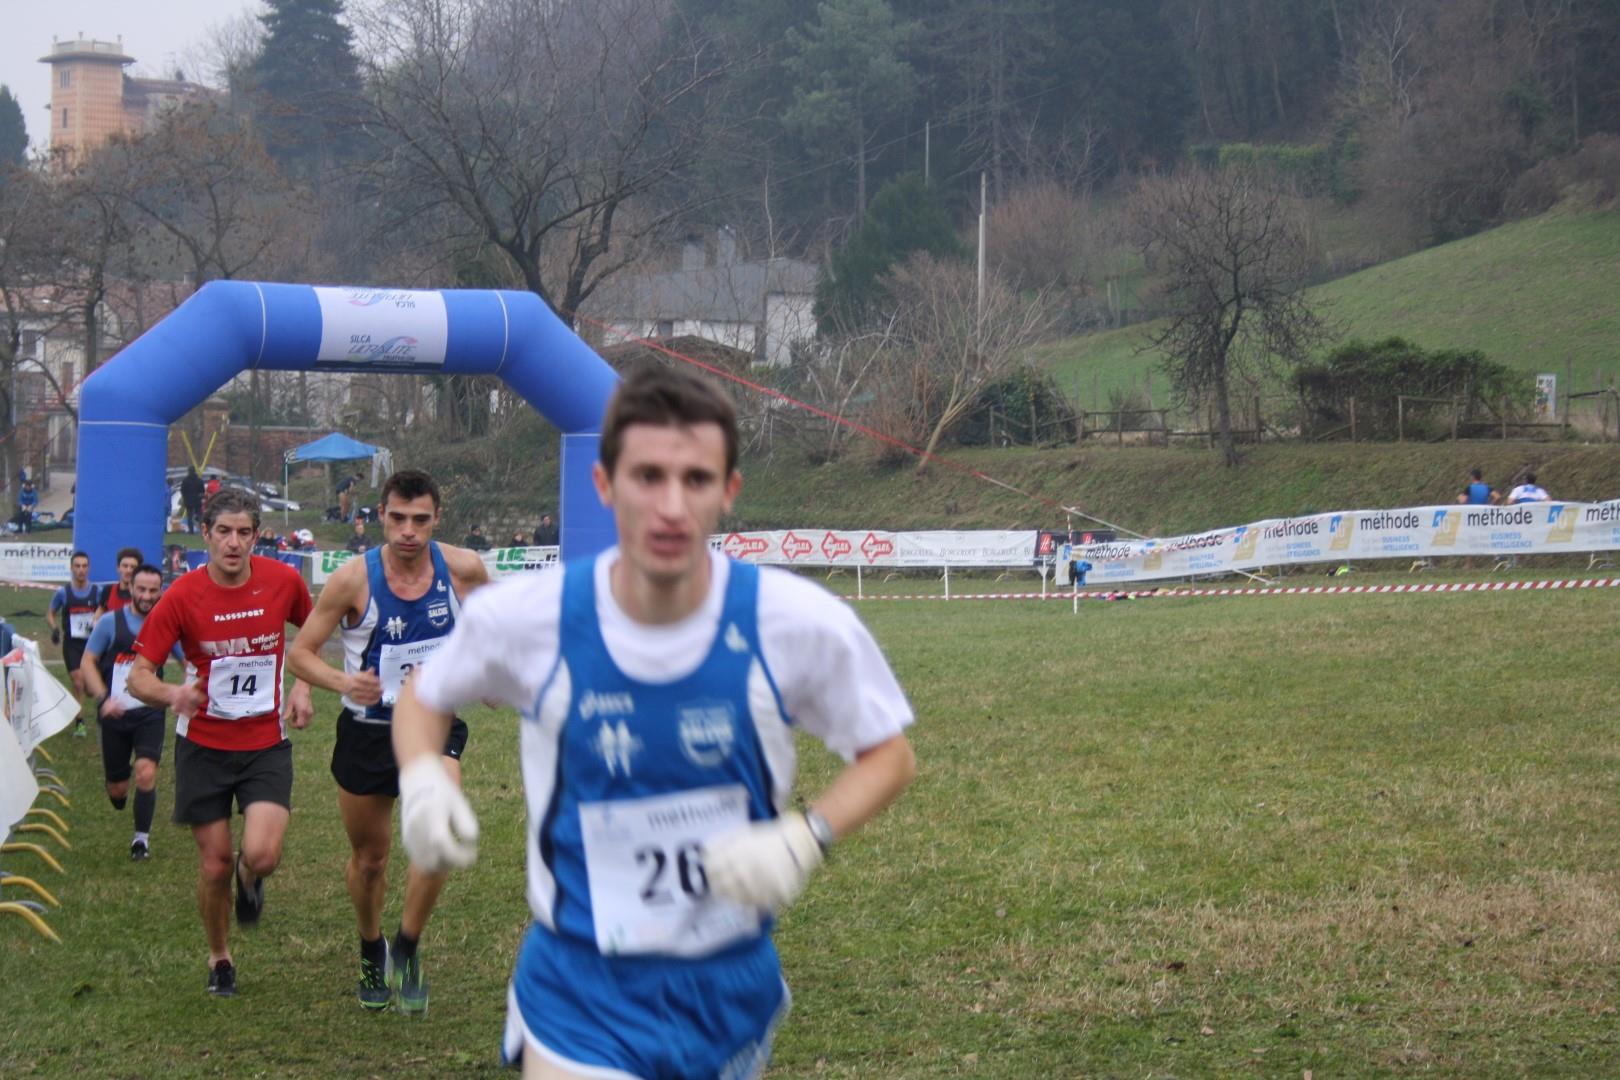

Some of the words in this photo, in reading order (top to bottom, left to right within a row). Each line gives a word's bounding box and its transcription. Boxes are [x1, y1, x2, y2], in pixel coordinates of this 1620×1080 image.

[350, 334, 371, 344] SILCA
[229, 674, 257, 696] 14
[635, 842, 711, 904] 26
